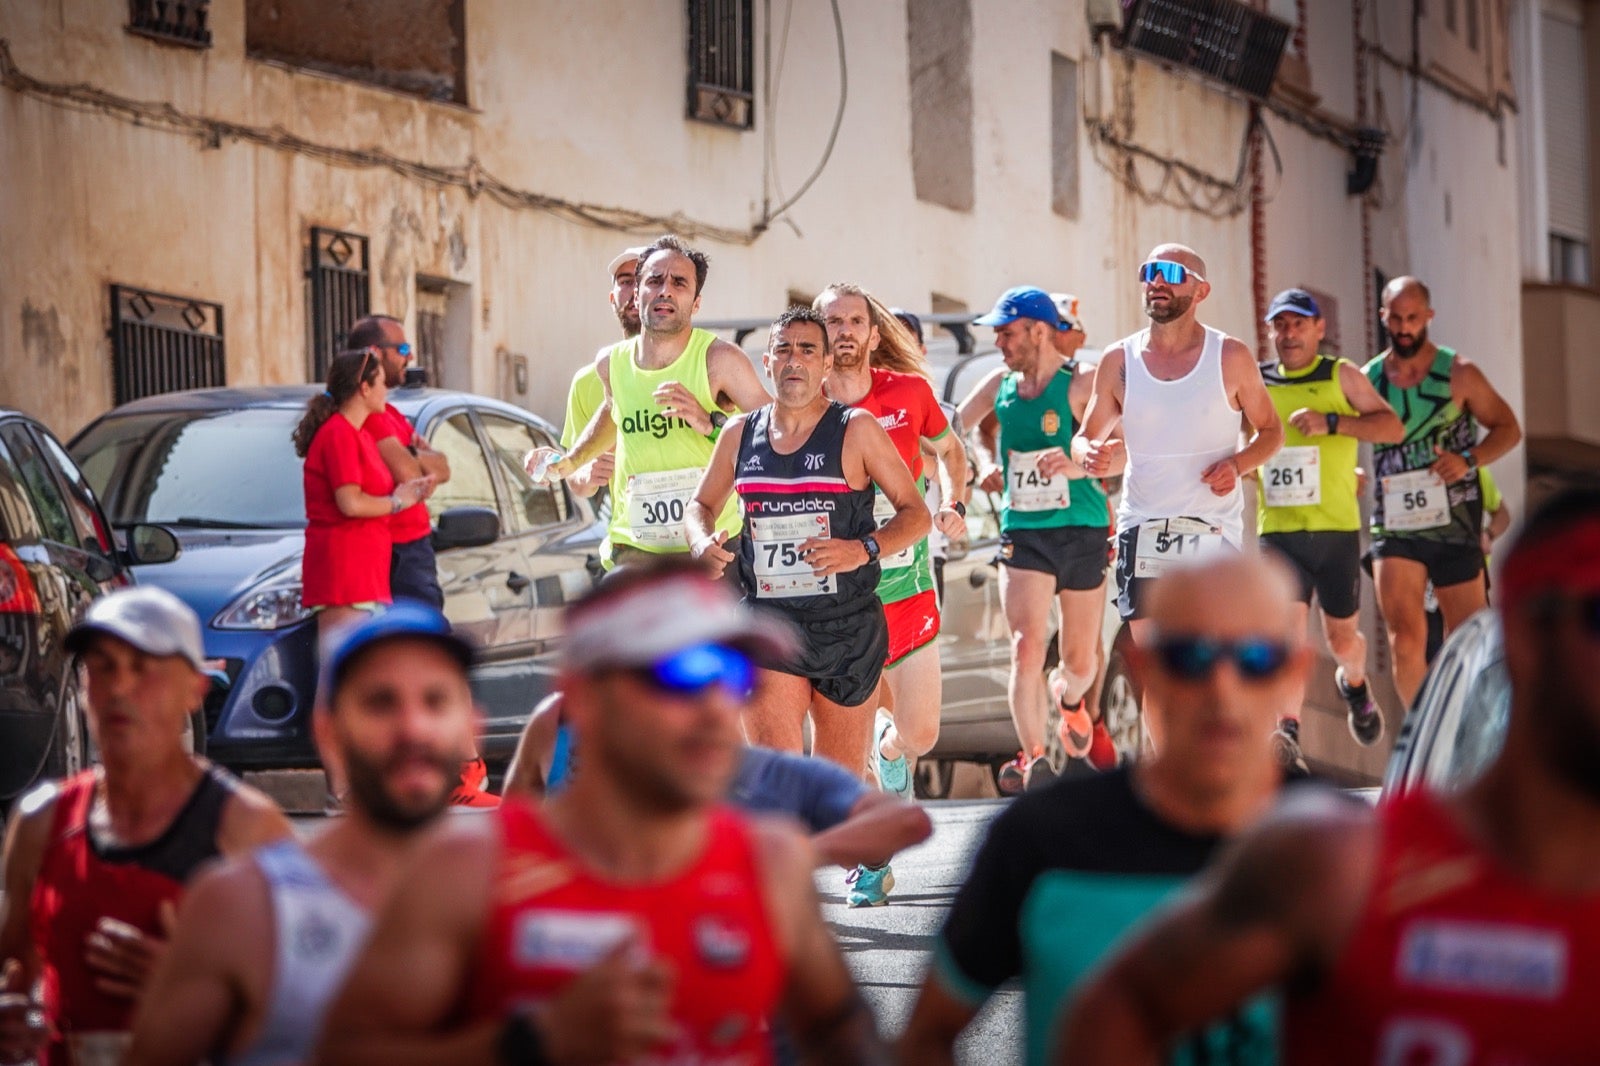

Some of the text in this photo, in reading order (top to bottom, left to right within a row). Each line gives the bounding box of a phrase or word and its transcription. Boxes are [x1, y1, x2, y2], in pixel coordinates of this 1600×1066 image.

[1271, 468, 1304, 486] 261
[642, 497, 691, 524] 300
[1404, 490, 1428, 510] 56
[1155, 532, 1200, 554] 511
